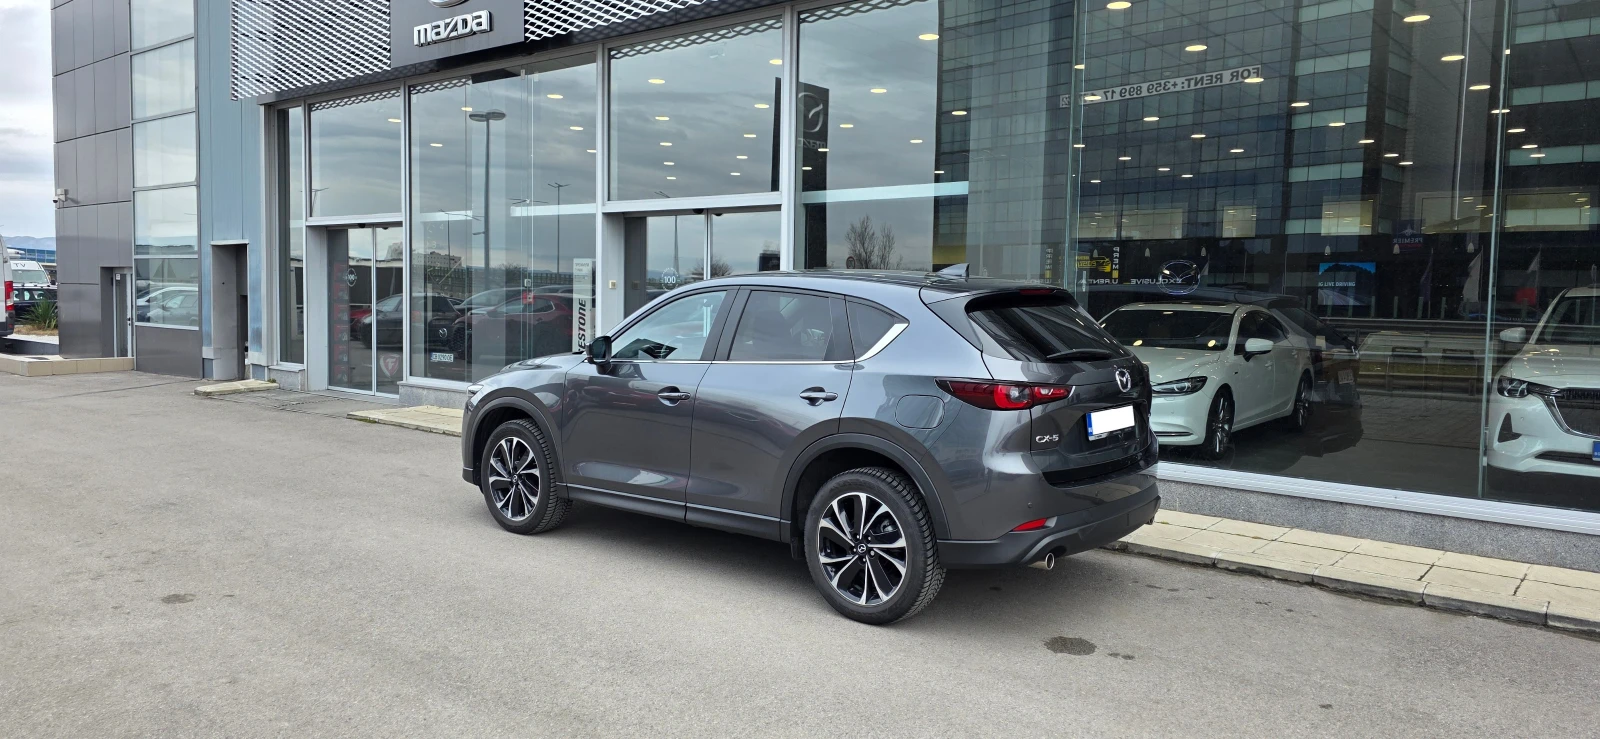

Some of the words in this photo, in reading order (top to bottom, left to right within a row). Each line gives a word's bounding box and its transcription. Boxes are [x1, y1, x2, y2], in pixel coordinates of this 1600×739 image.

[413, 10, 491, 46] mazda
[663, 276, 676, 284] 100
[578, 298, 586, 351] ESTONE
[1035, 434, 1060, 443] CX-5
